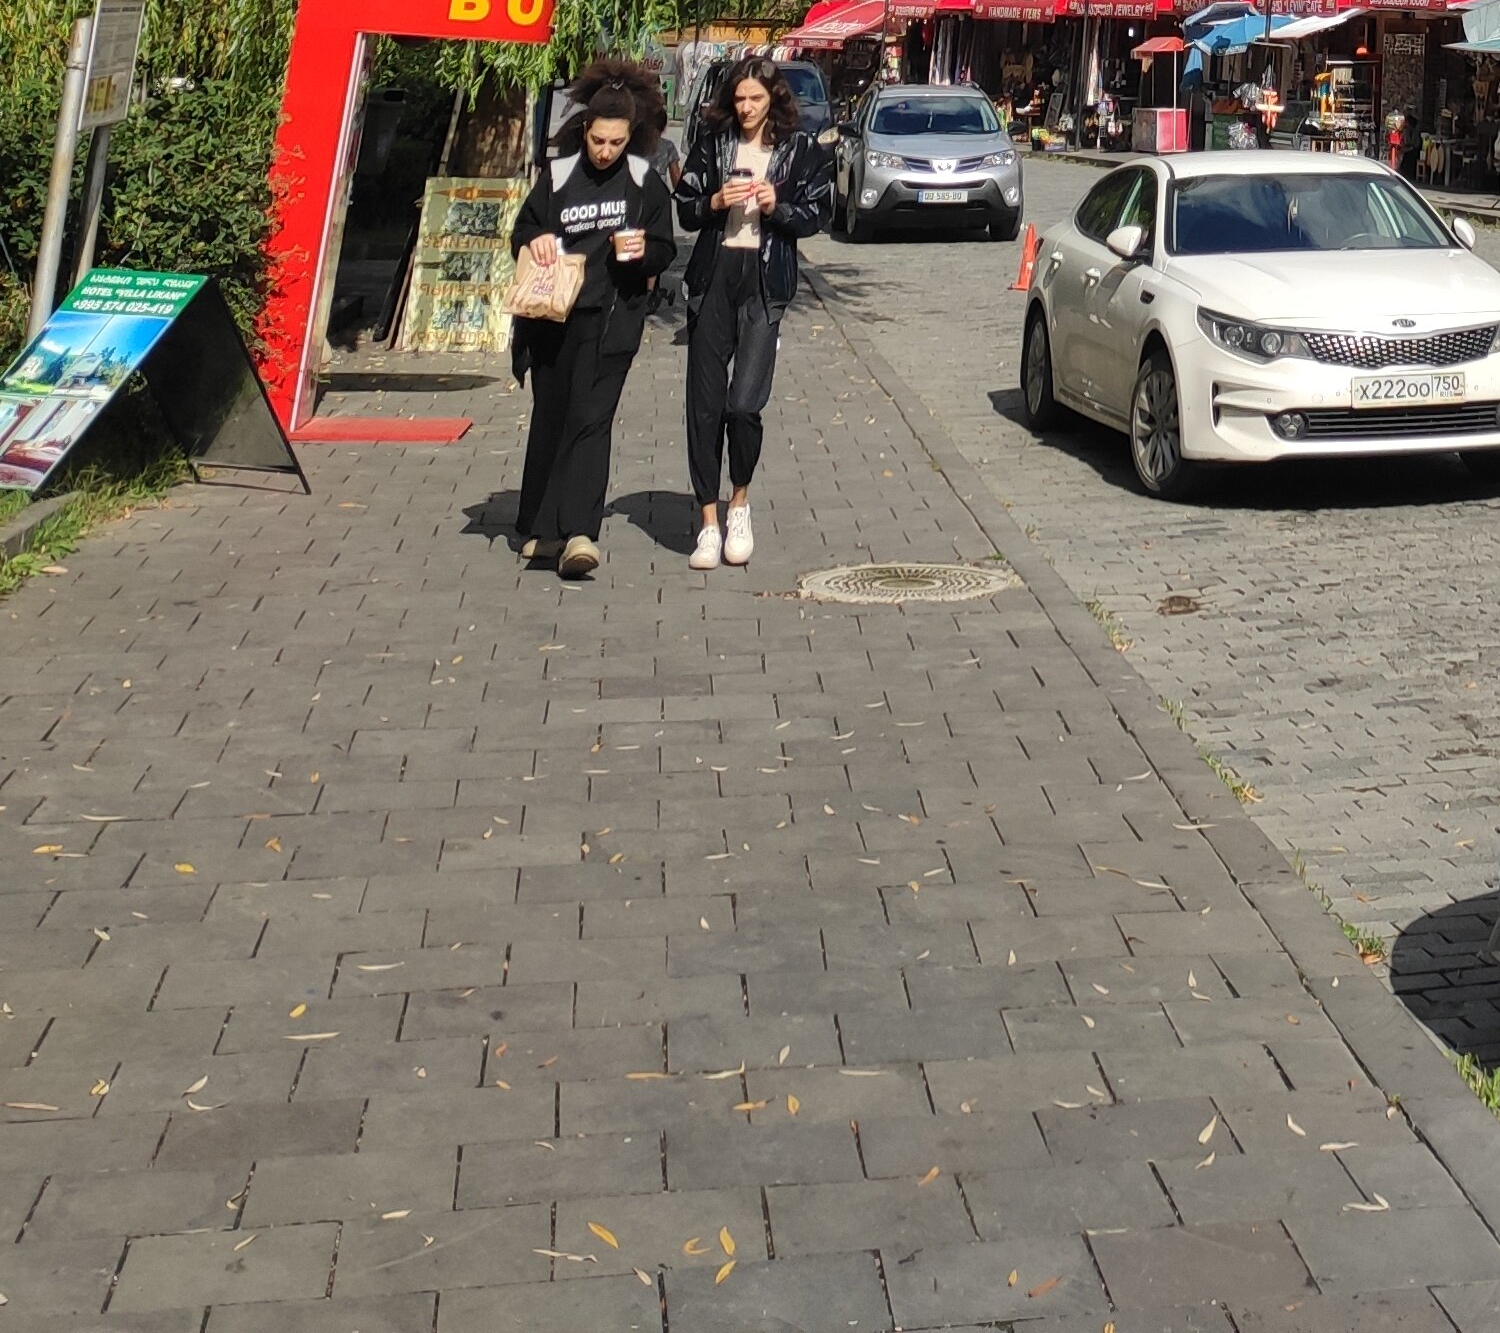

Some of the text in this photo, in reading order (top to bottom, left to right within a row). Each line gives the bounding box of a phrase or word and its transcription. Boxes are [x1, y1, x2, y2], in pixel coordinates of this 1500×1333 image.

[988, 6, 1021, 19] HANDMADE
[561, 204, 598, 224] GOOD
[565, 216, 620, 233] makes good
[81, 286, 113, 297] HOTEL
[72, 300, 174, 314] +995 574 025-419
[1434, 375, 1460, 392] 750
